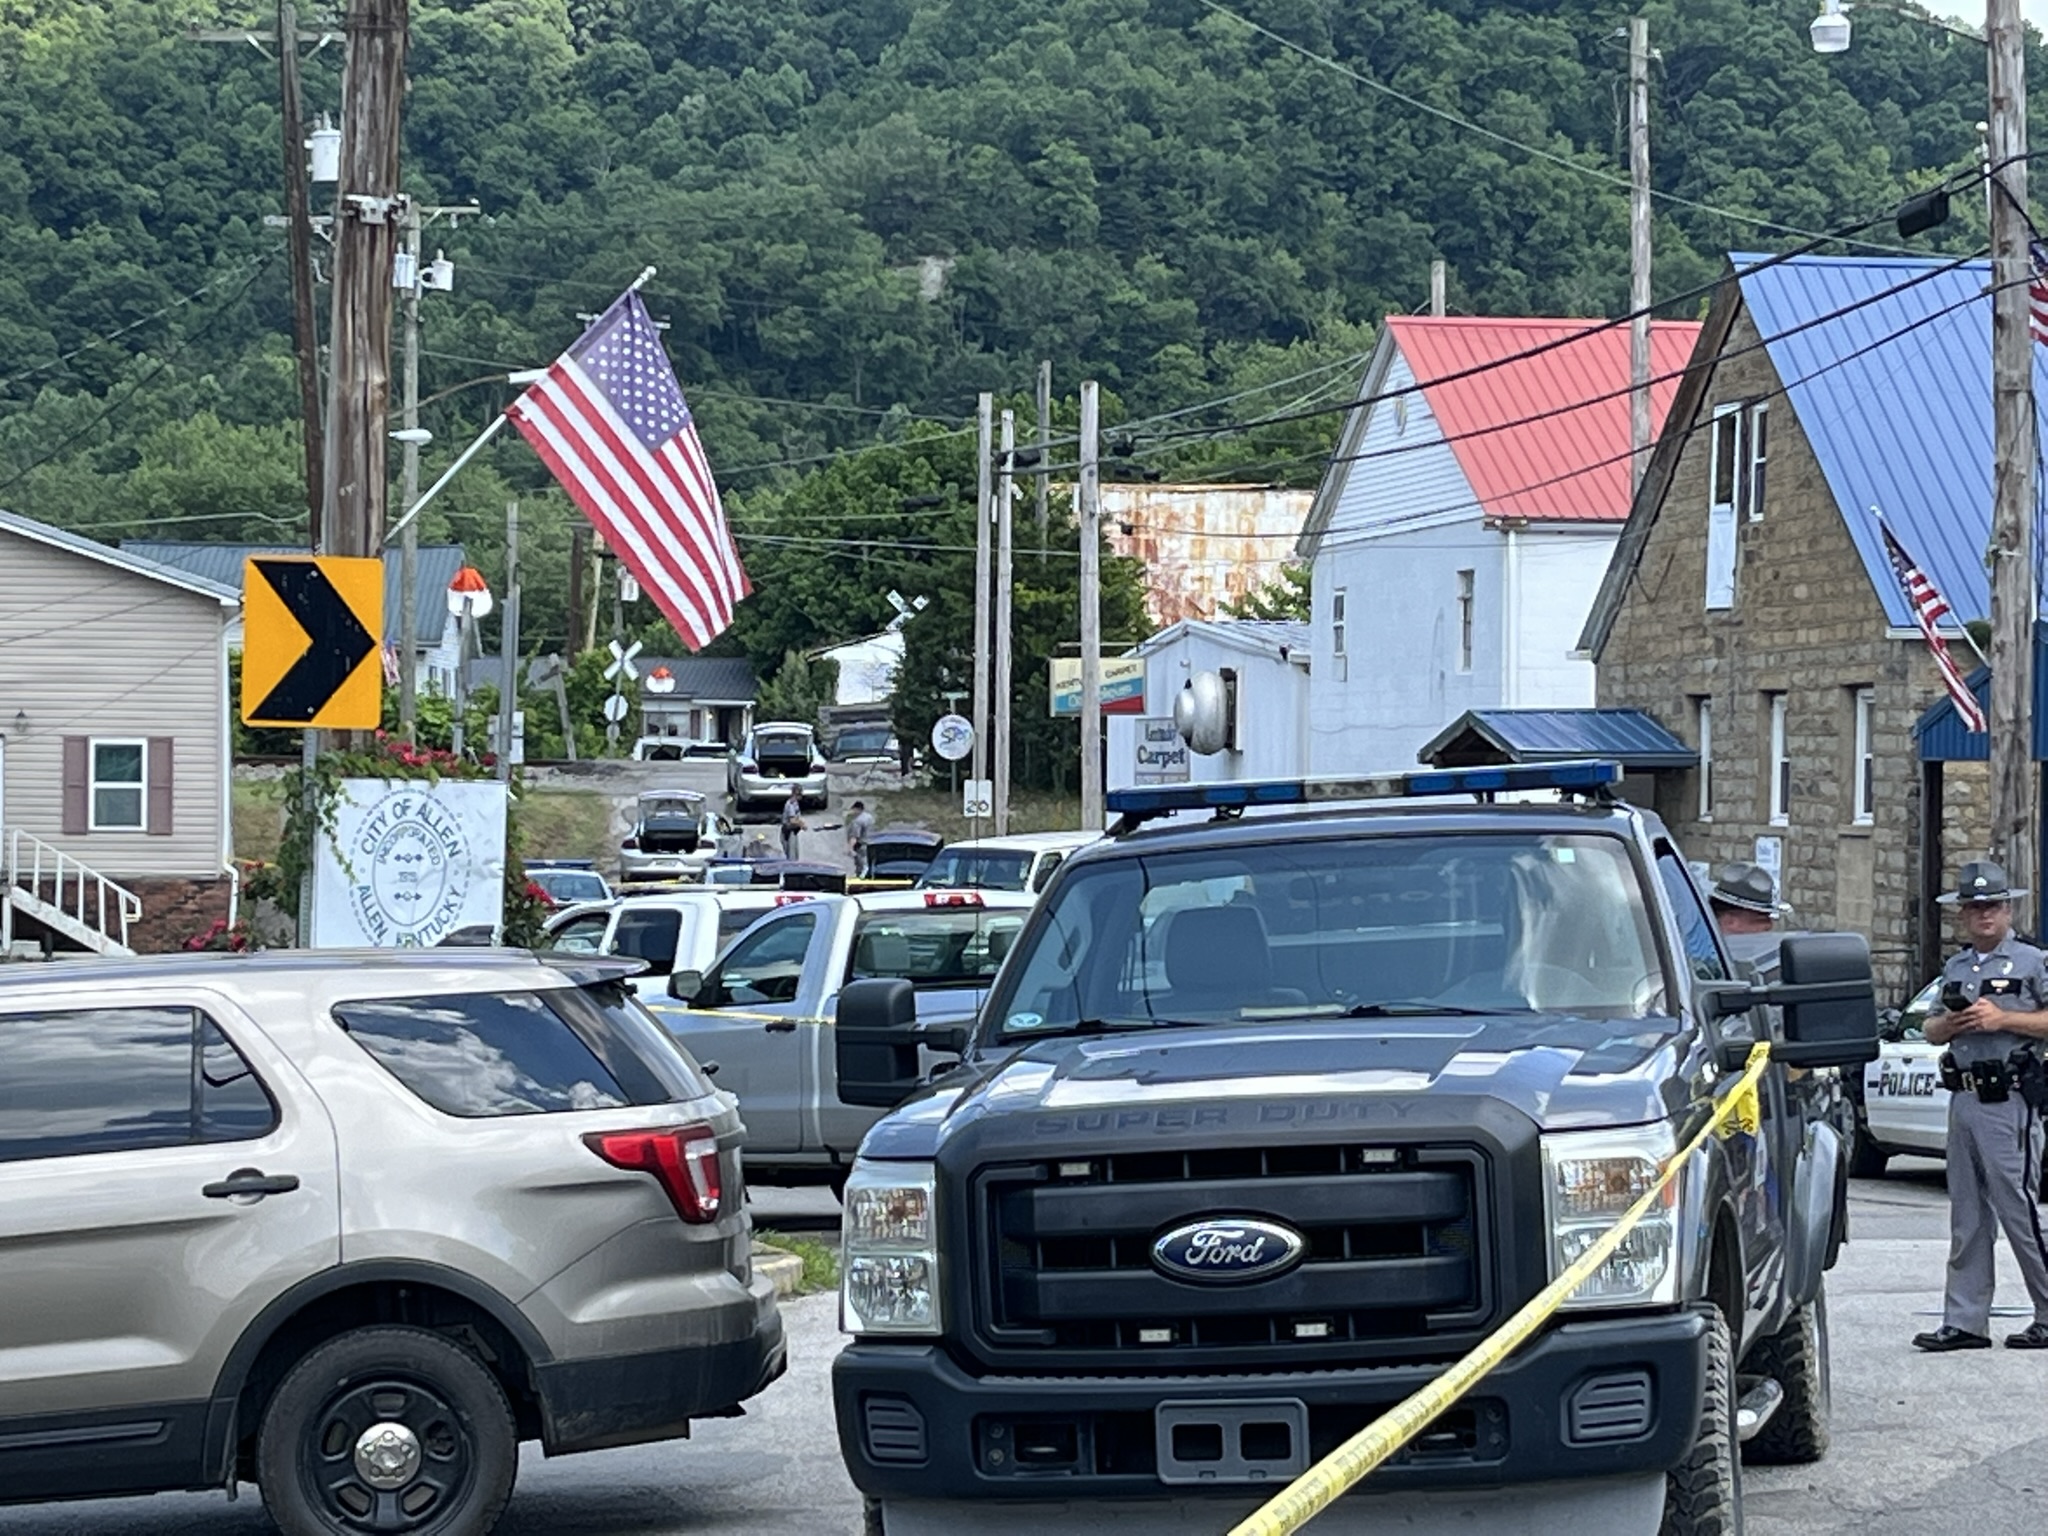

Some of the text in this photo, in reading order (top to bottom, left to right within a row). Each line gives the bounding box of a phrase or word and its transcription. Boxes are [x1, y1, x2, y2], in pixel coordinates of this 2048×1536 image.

[1137, 745, 1185, 769] Carpet
[966, 800, 989, 813] 20
[361, 798, 463, 858] CITY OF ALLEN
[356, 884, 389, 940] ALLEN
[1878, 1072, 1936, 1097] POLICE
[1033, 1100, 1419, 1136] SUPER DUTY
[1184, 1228, 1267, 1266] Ford
